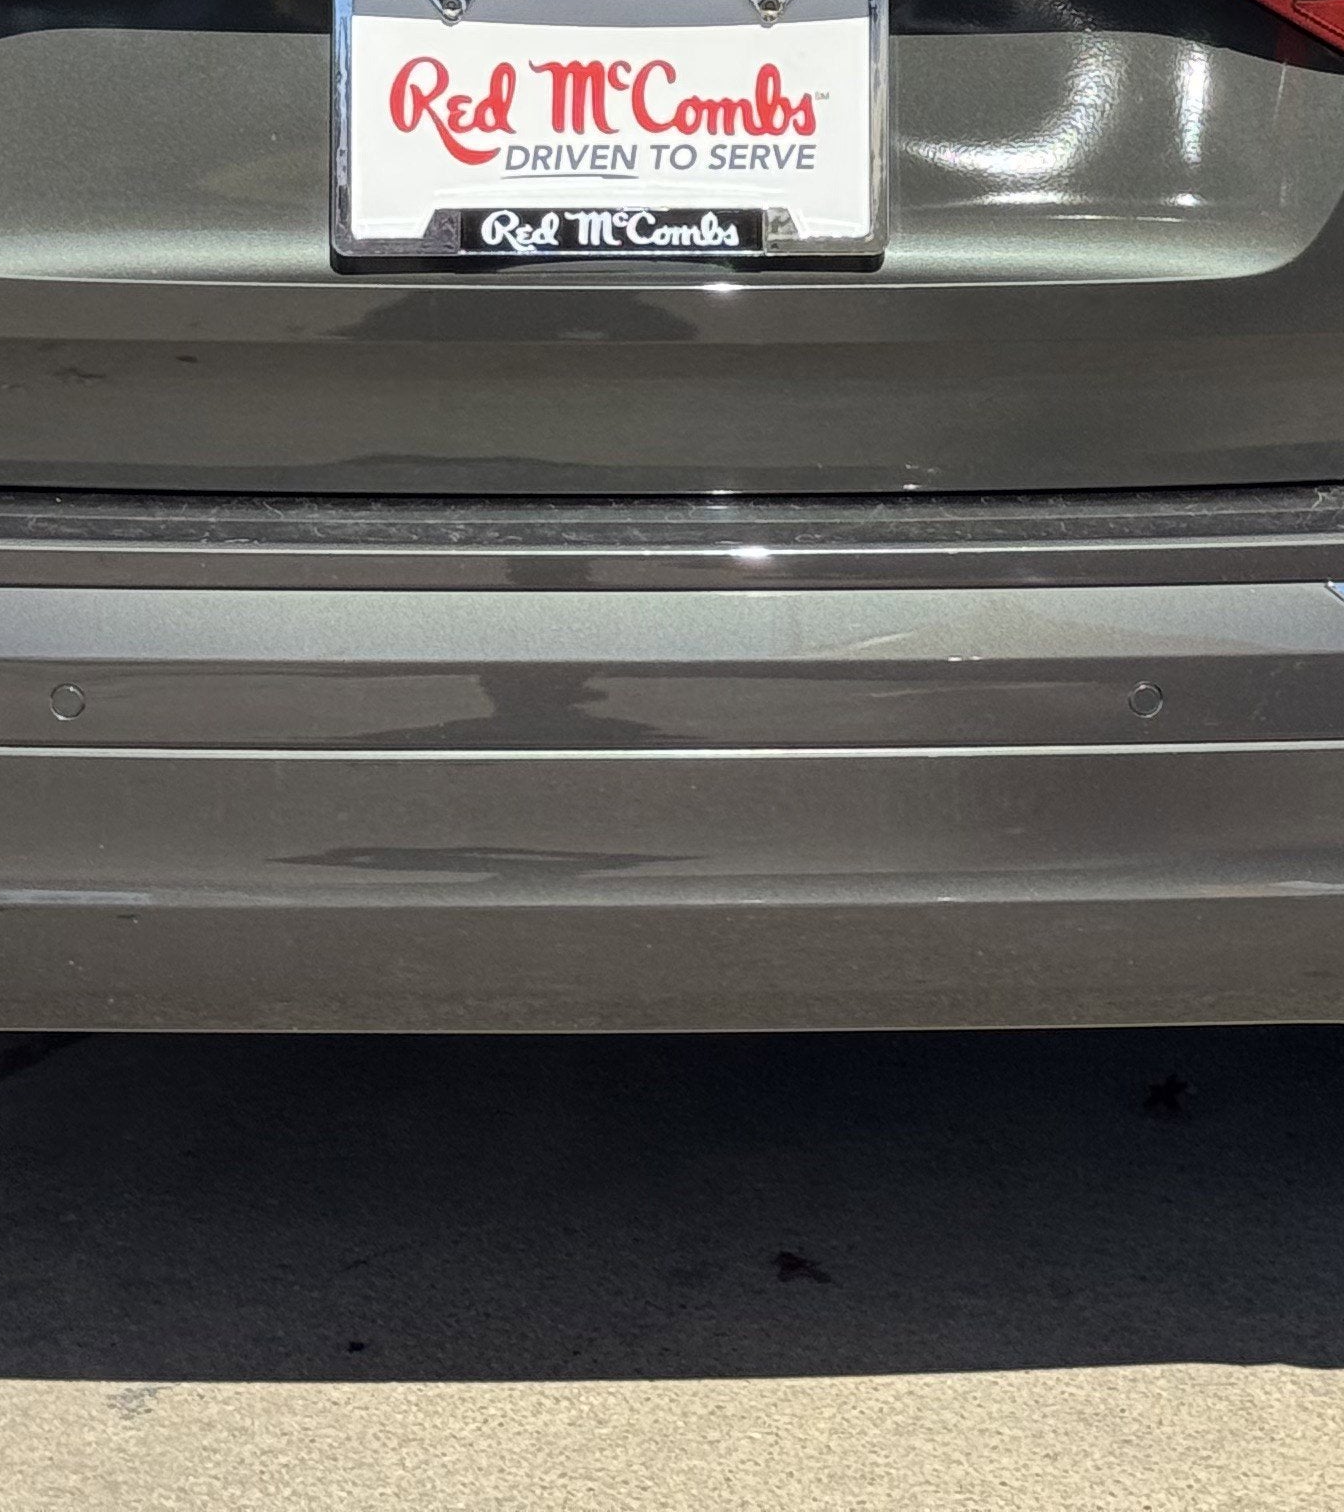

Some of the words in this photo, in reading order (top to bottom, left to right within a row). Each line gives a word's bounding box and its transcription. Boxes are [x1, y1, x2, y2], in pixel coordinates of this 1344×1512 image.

[390, 56, 518, 165] Red
[529, 59, 817, 137] McCombs
[505, 144, 638, 171] DRIVEN
[649, 143, 698, 171] TO
[709, 143, 818, 171] SERVE
[481, 209, 560, 252] Red
[564, 210, 740, 247] McCombs
